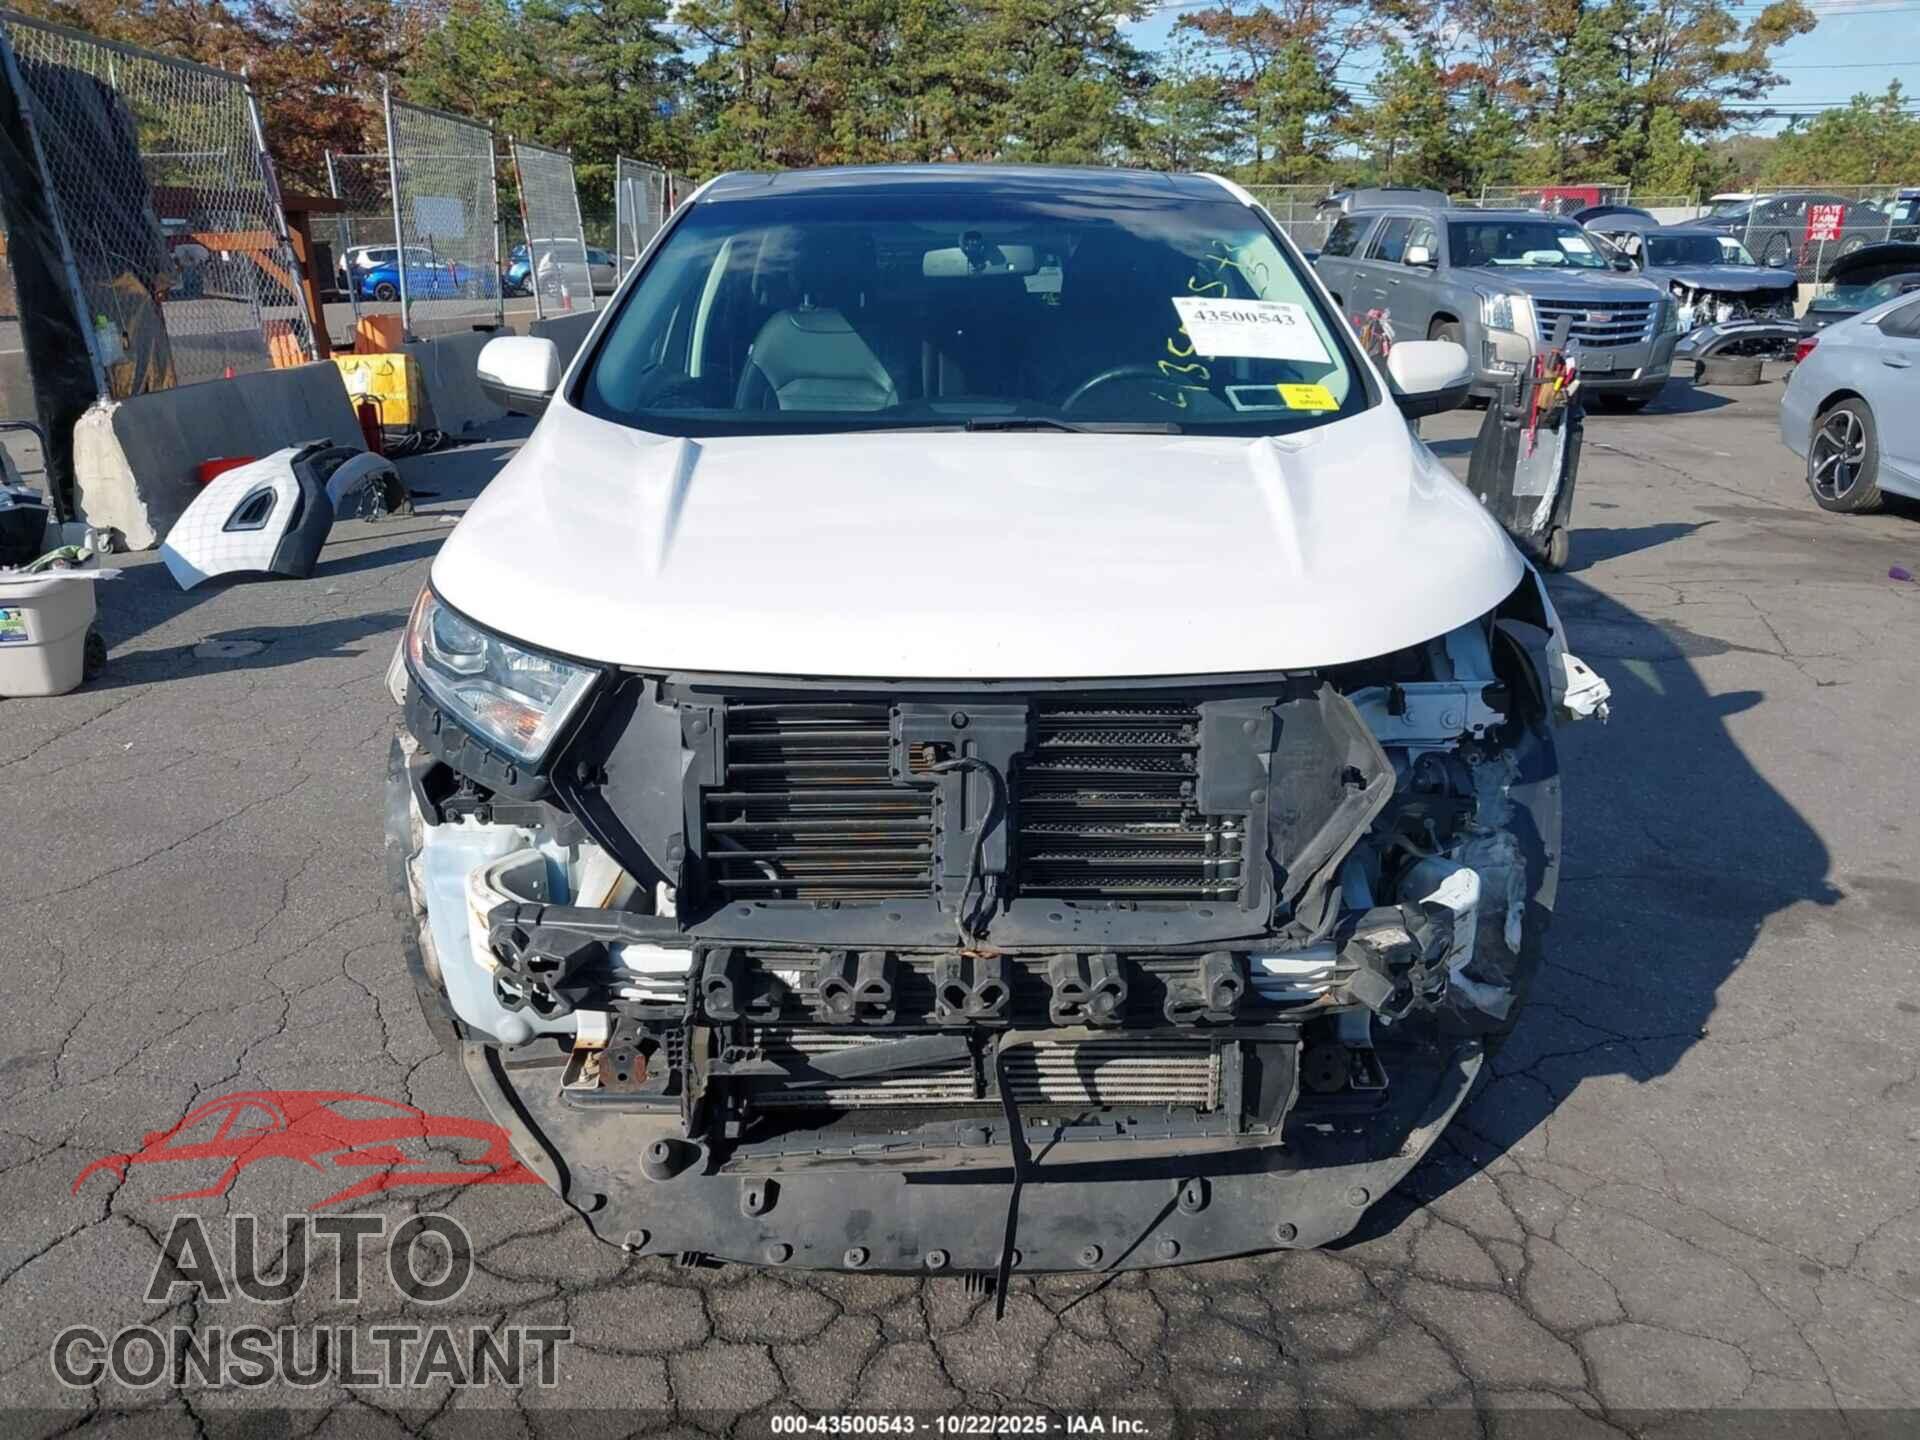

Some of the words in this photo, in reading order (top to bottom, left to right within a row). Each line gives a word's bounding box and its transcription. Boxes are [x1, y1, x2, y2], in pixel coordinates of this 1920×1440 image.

[1812, 205, 1841, 214] STATE
[1812, 214, 1839, 223] FARM
[1809, 231, 1835, 240] AREA
[1193, 309, 1296, 326] 43500543
